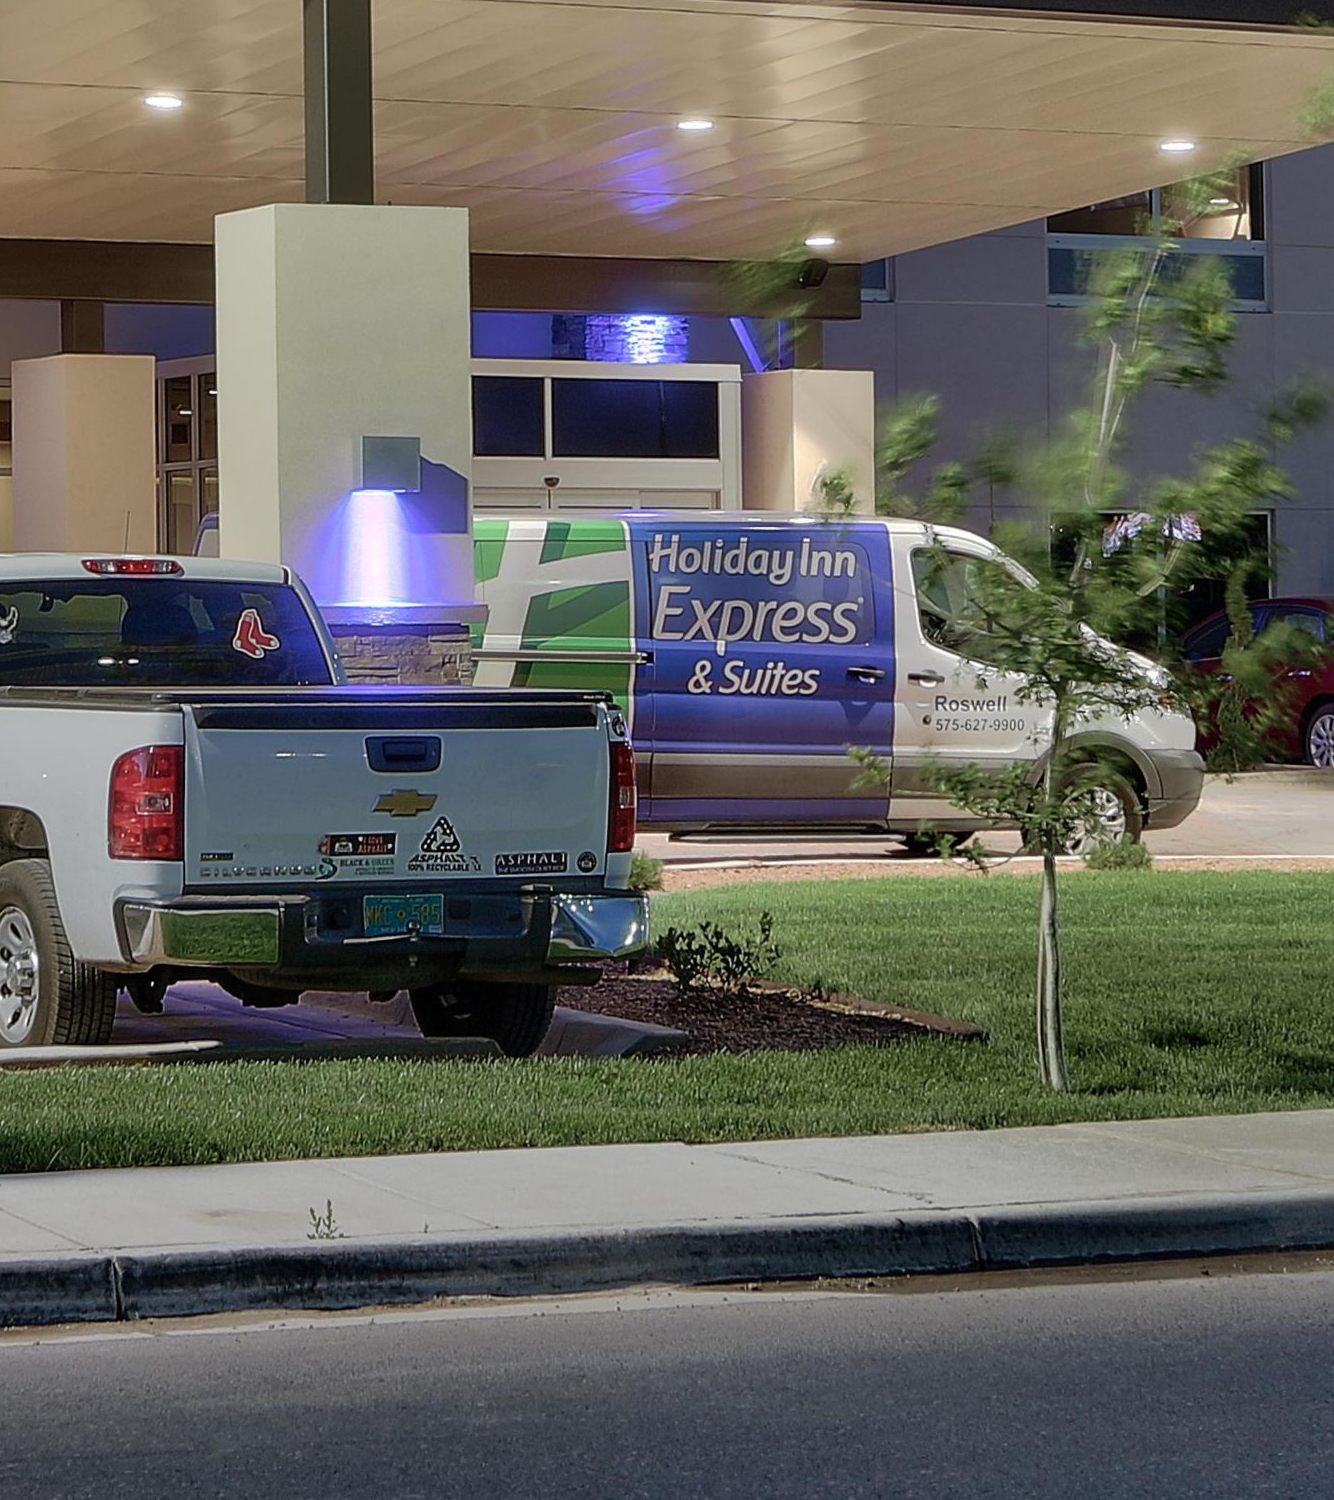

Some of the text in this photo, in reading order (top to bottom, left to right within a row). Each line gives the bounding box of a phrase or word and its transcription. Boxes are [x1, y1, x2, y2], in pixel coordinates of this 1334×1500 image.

[648, 533, 857, 585] Holiday Inn
[651, 584, 860, 657] Express
[686, 659, 821, 695] & Suites
[934, 695, 1007, 712] Roswell
[935, 718, 1025, 732] 575-627-9900
[409, 853, 467, 863] ASPHALT
[496, 852, 566, 866] ASPHALT
[410, 903, 441, 925] 585
